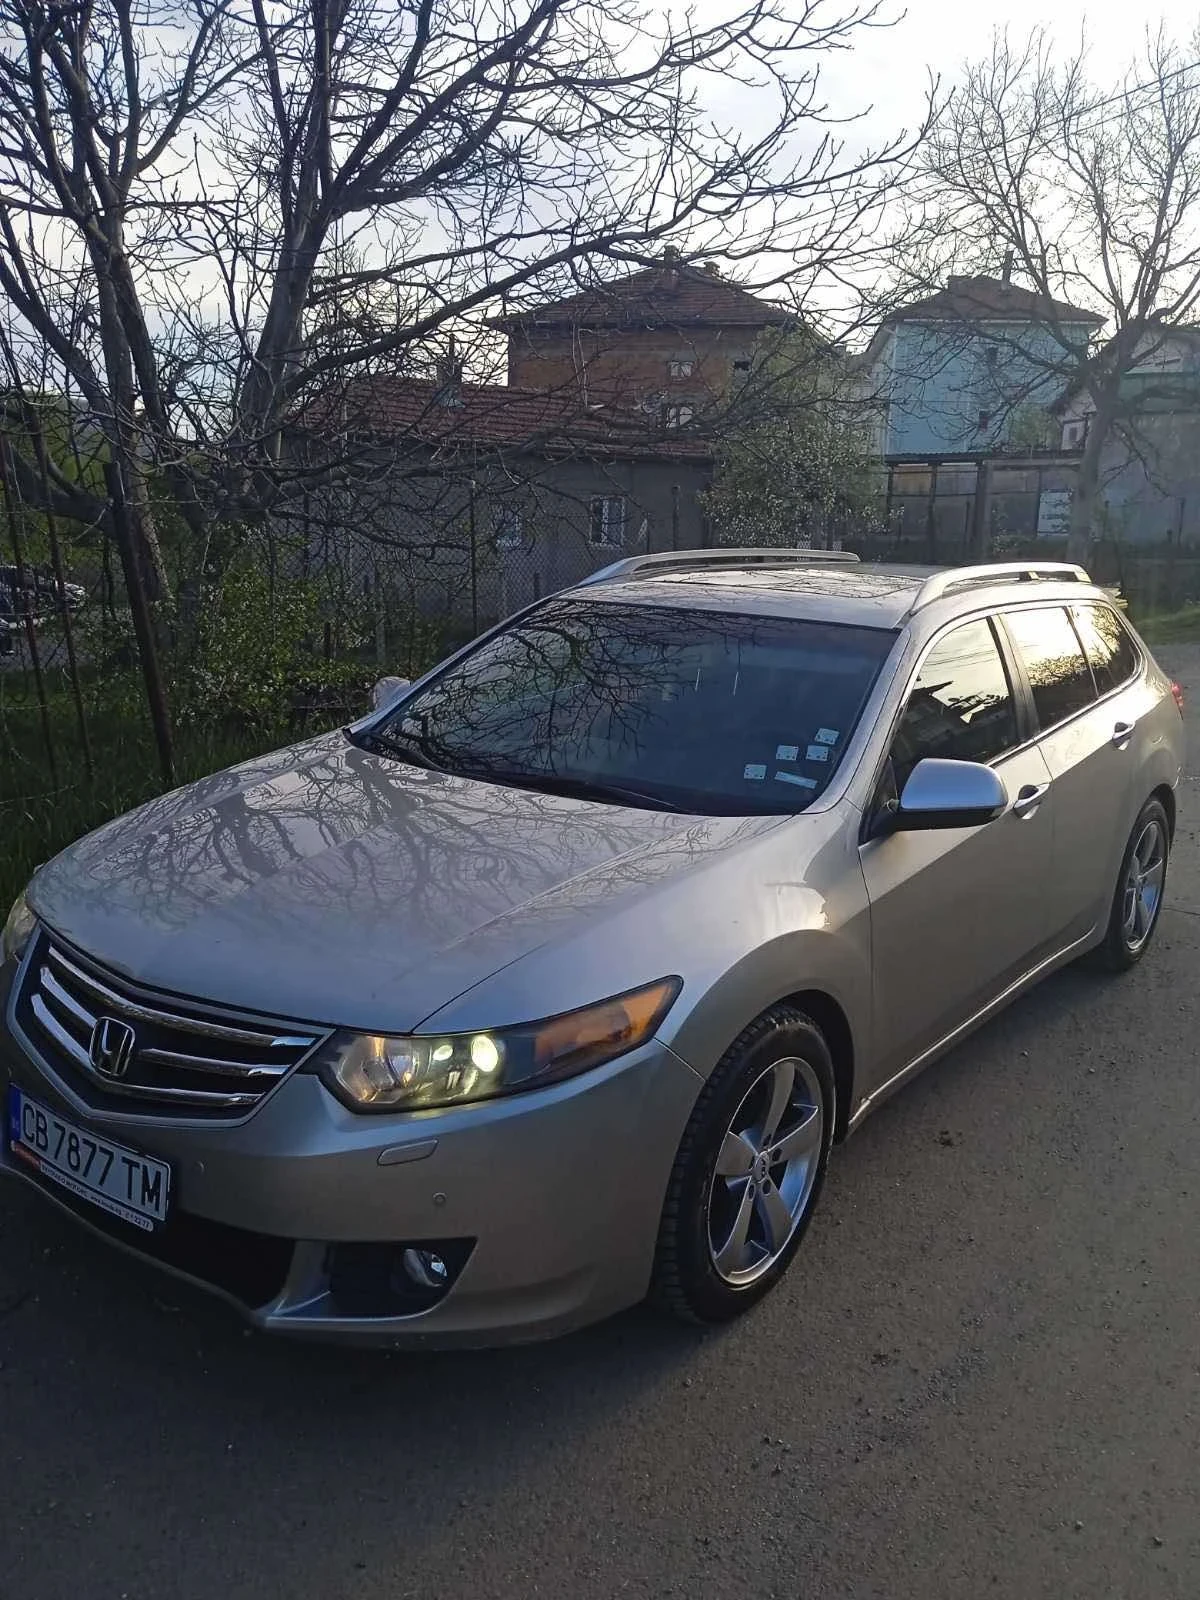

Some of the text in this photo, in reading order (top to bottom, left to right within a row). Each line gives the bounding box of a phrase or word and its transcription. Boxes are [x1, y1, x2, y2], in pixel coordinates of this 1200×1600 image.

[23, 1103, 48, 1151] CB
[54, 1121, 114, 1186] 7877
[121, 1157, 161, 1211] TM
